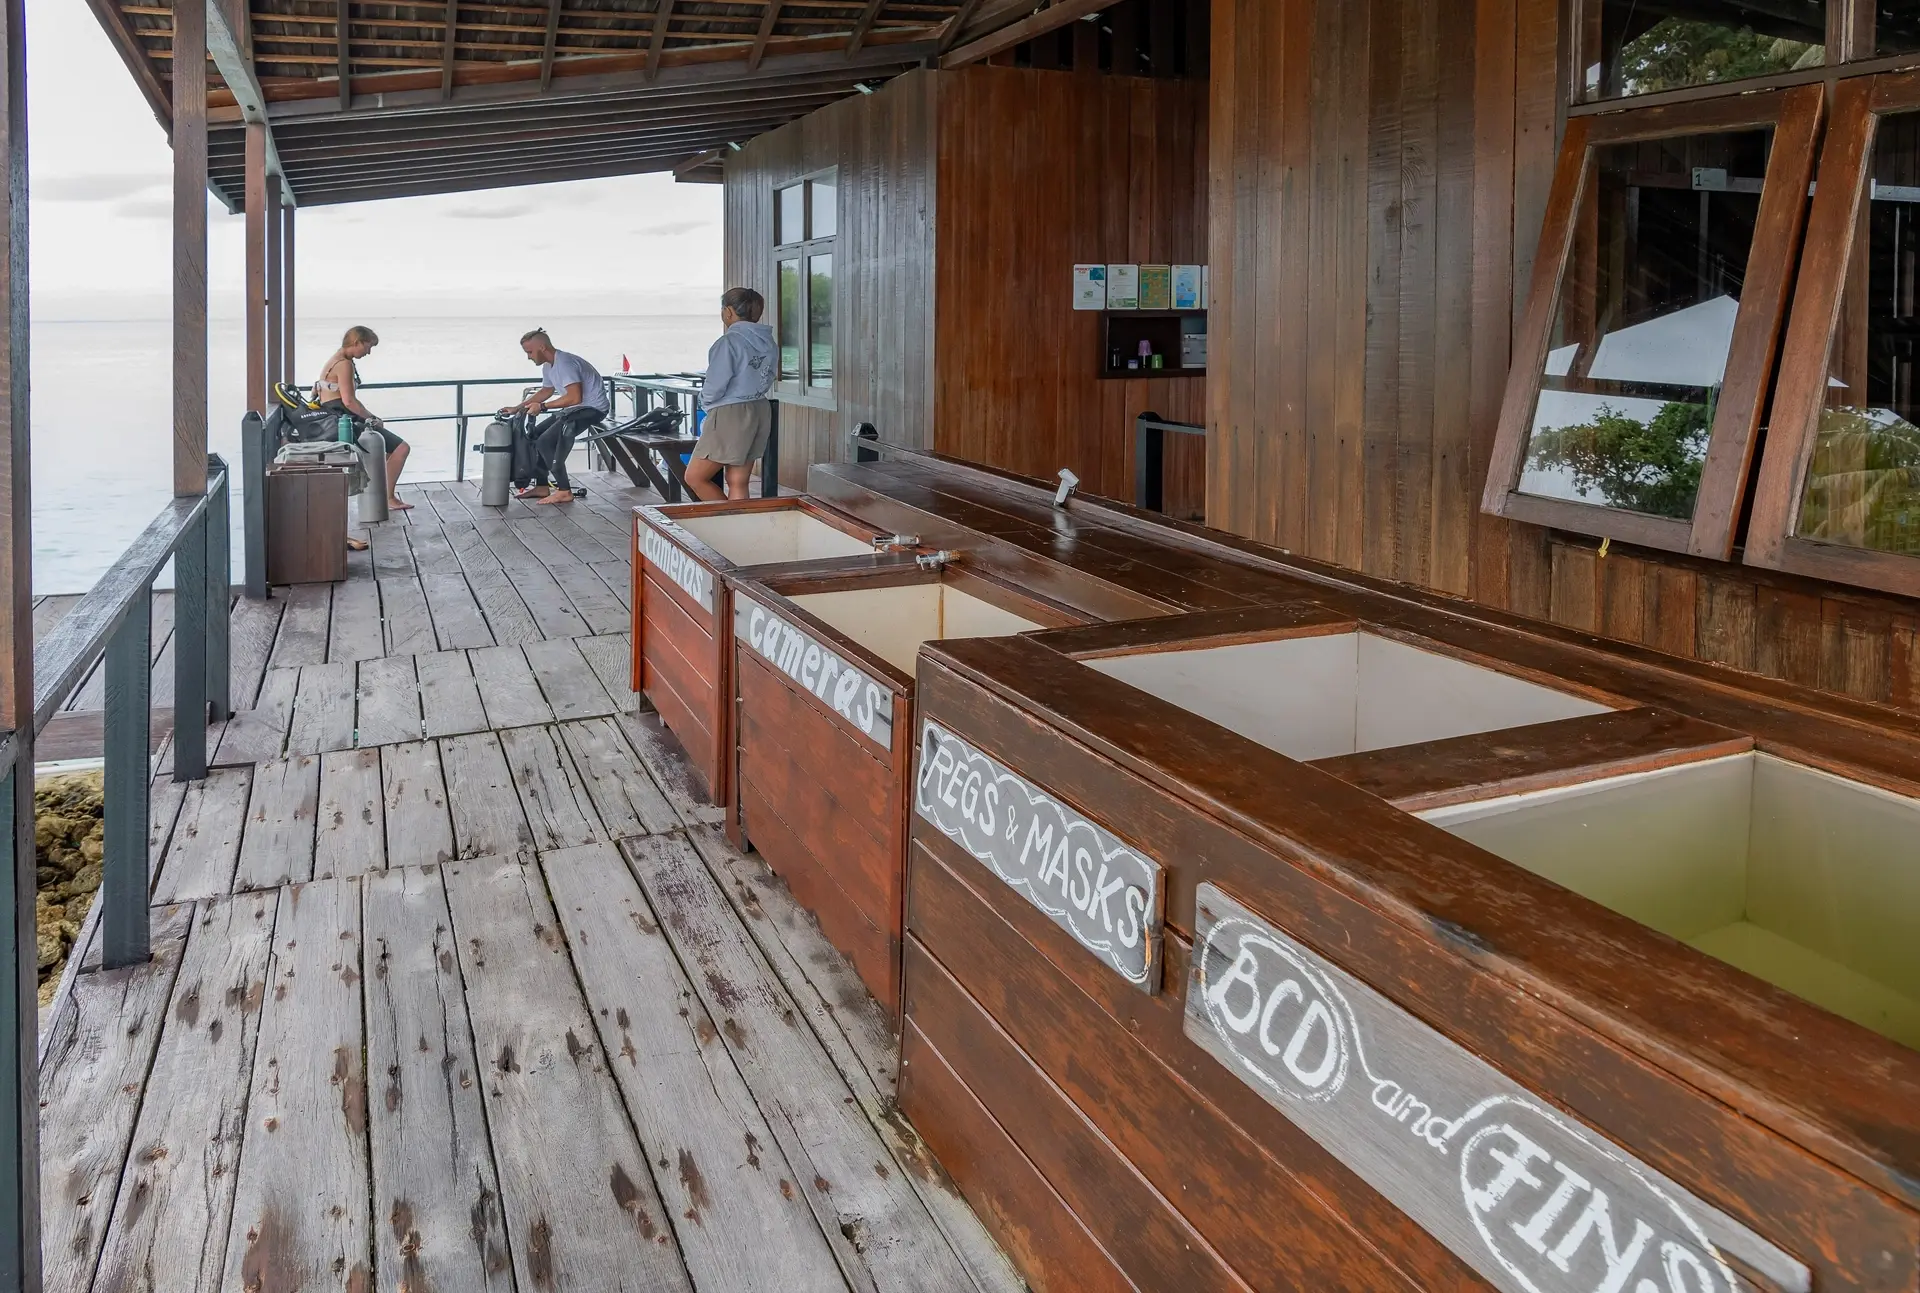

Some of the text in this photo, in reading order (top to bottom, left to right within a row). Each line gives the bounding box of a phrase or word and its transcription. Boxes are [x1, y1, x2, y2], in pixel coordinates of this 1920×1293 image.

[645, 528, 703, 603] cameras
[749, 606, 881, 735] cameras
[922, 744, 1145, 949] REGS & MASKS
[1207, 947, 1715, 1293] BCD and FINS
